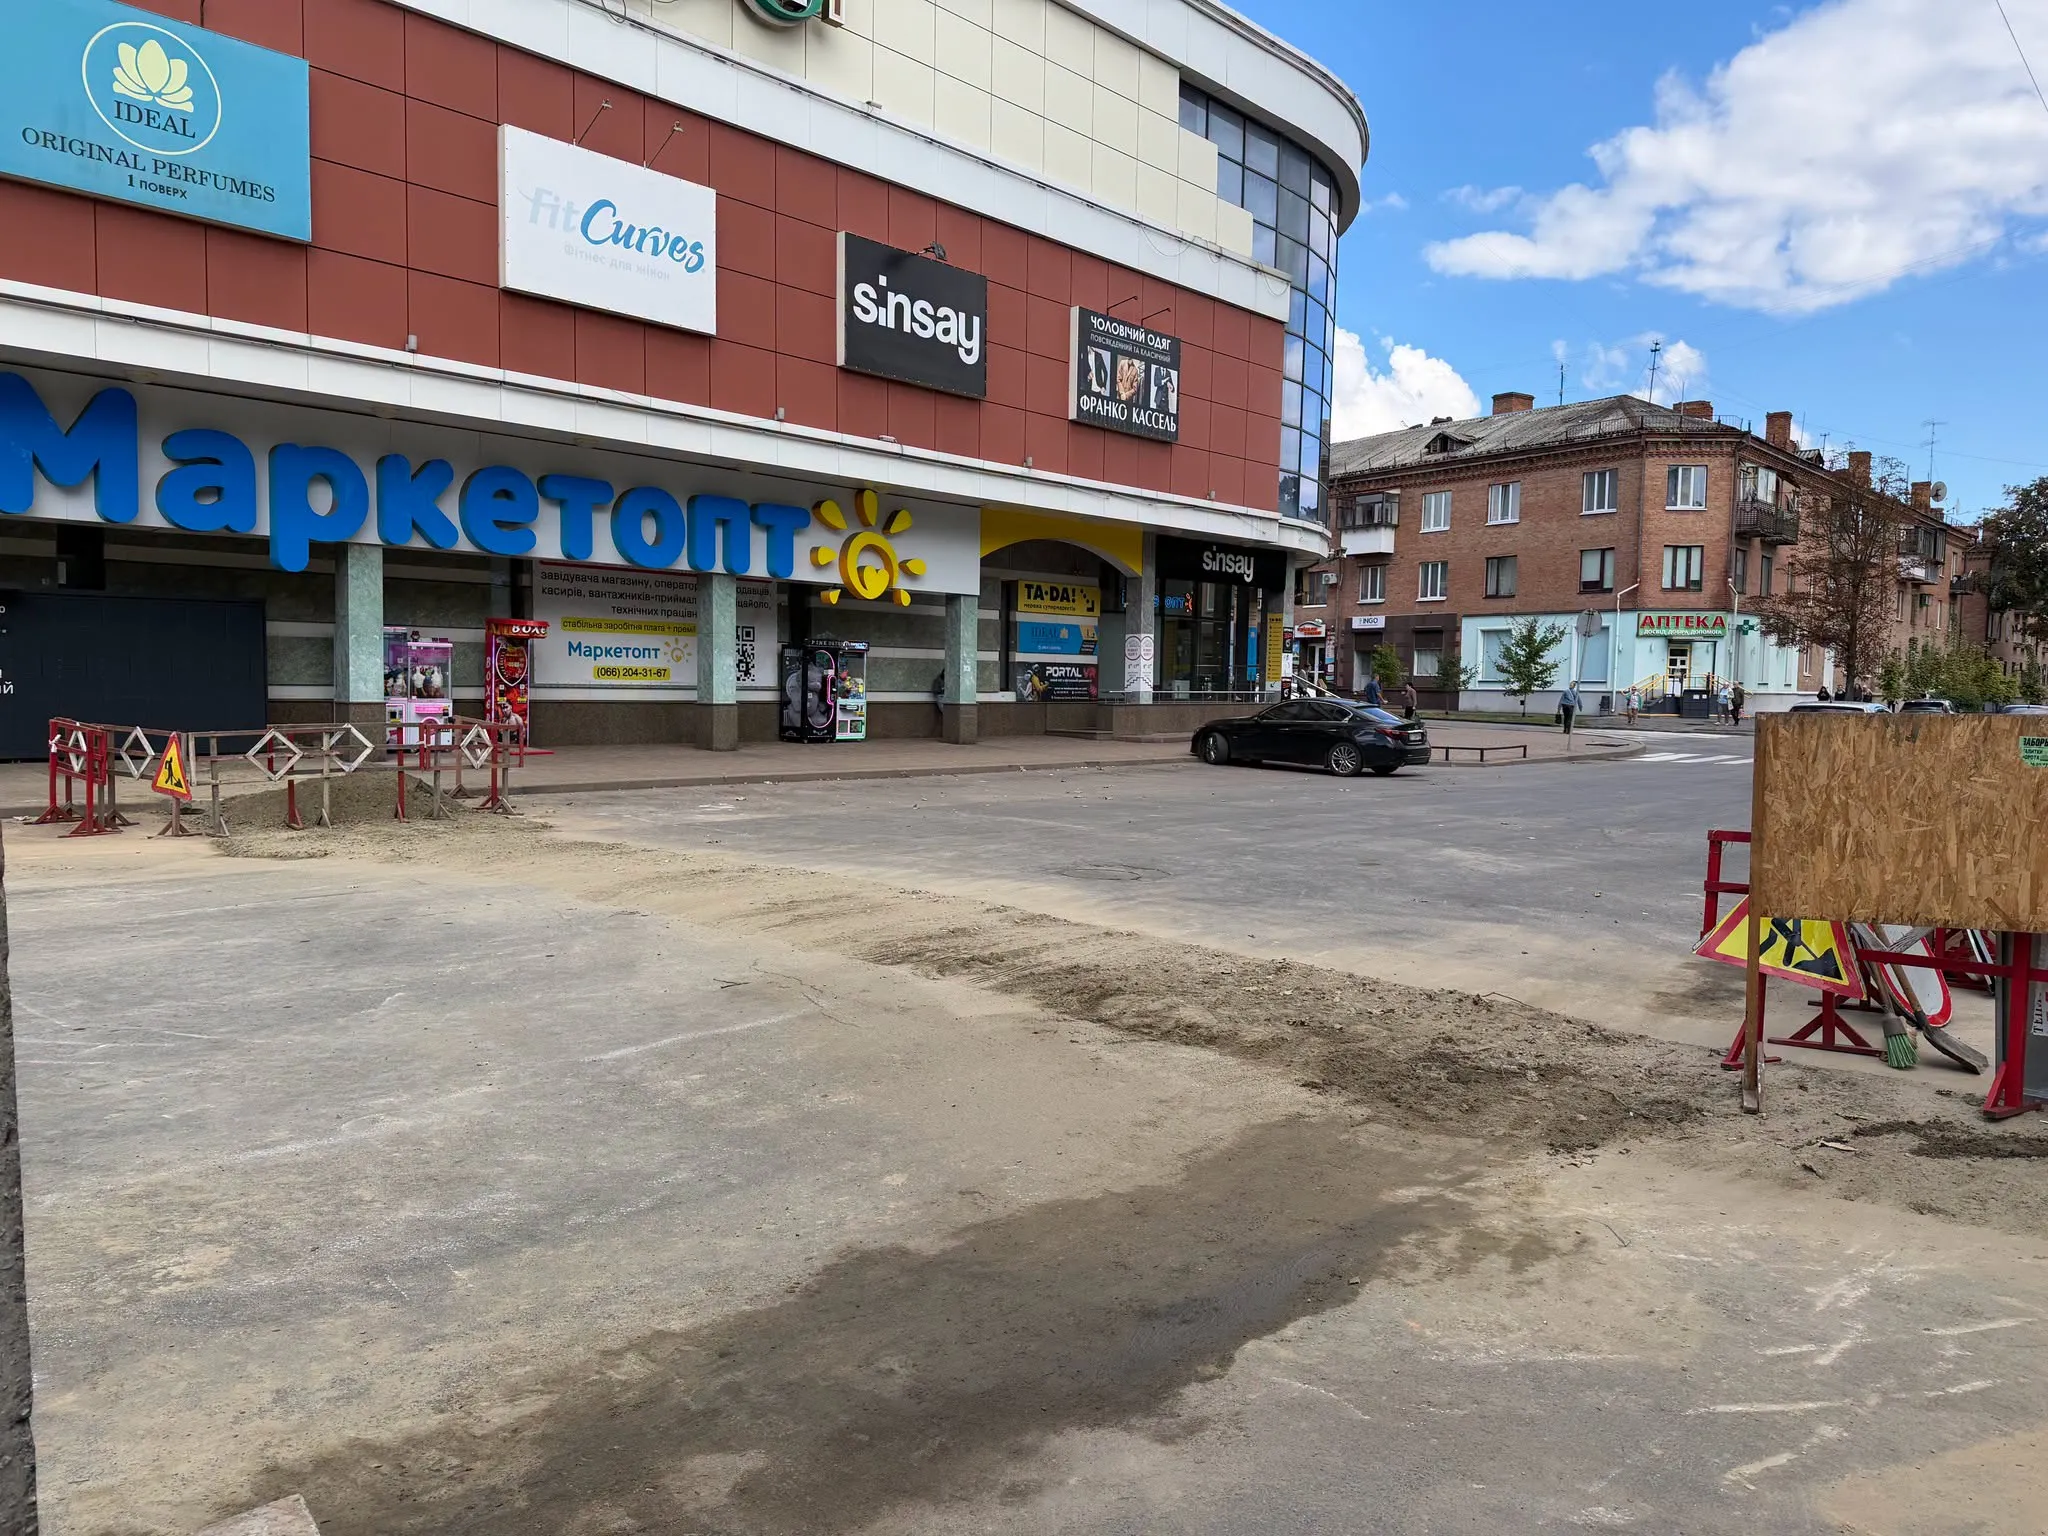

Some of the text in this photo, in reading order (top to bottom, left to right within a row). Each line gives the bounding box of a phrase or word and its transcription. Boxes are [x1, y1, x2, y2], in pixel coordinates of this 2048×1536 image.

[114, 100, 196, 139] IDEAL
[22, 127, 276, 203] ORIGINAL PERFUMES
[127, 174, 136, 188] 1
[852, 274, 980, 365] sinsay
[1090, 315, 1172, 351] ЧОЛОВІЧИЙ ОДЯГ
[1079, 394, 1177, 432] ФРАНКО КАССЕЛЬ
[0, 370, 811, 579] Маркетопт
[1202, 545, 1254, 583] sinsay
[540, 571, 599, 584] завідувача
[601, 575, 652, 589] магазину,
[541, 586, 587, 598] касирів,
[611, 605, 658, 616] технічних
[562, 618, 603, 629] стабільна
[1362, 617, 1379, 625] INGO
[1640, 615, 1726, 629] АПТЕКА
[567, 641, 660, 661] Маркетопт
[596, 667, 667, 679] (066) 204-31-67
[1045, 666, 1082, 678] PORTAL
